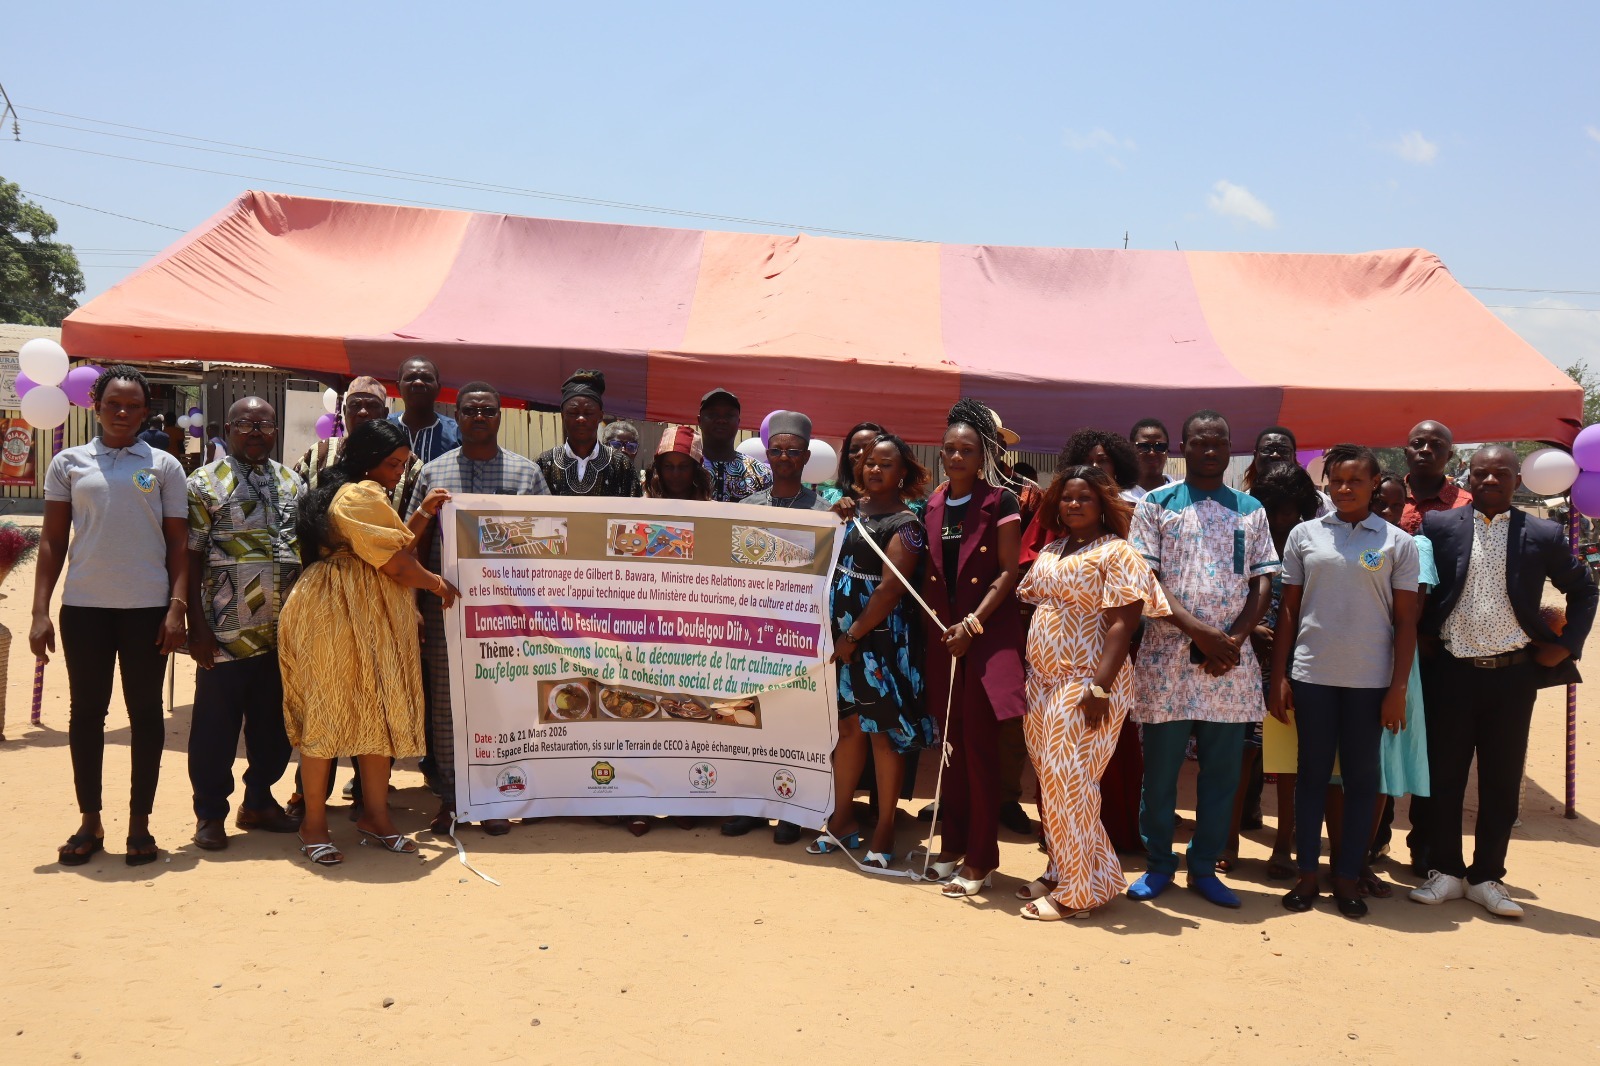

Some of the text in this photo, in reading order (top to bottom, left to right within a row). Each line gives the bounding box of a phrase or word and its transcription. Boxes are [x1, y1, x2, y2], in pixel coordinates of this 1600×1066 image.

[482, 566, 814, 595] Sous le haut patronage de Gilbert B. Bawara, Ministre des Relations avec le Parlement
[469, 585, 478, 597] et
[479, 583, 491, 596] les
[492, 584, 536, 597] Institutions
[537, 585, 546, 597] et
[547, 585, 566, 597] avec
[567, 584, 595, 601] l'appui
[596, 586, 636, 602] technique
[637, 587, 648, 600] du
[649, 588, 687, 602] Ministère
[688, 590, 699, 604] du
[700, 592, 737, 607] tourisme,
[738, 593, 749, 607] de
[750, 594, 757, 608] la
[758, 596, 785, 610] culture
[785, 599, 794, 611] et
[794, 599, 809, 613] des
[475, 611, 527, 631] Lancement
[528, 610, 560, 632] officiel
[561, 611, 574, 632] du
[575, 612, 611, 634] Festival
[613, 614, 647, 635] annuel
[657, 615, 675, 637] Taa
[676, 616, 725, 644] Doufelgou
[726, 620, 743, 642] Diit
[775, 627, 813, 650] édition
[480, 640, 515, 659] Thème
[522, 640, 591, 660] Consommons
[594, 641, 623, 663] local,
[625, 645, 633, 662] à
[635, 646, 647, 662] la
[649, 645, 708, 668] découverte
[709, 650, 723, 669] de
[725, 651, 747, 672] l'art
[748, 654, 793, 677] culinaire
[794, 660, 809, 677] de
[474, 657, 818, 694] Doufelgou sous le signe de la cohésion social et du vivre ensemble
[474, 733, 493, 744] Date
[498, 733, 508, 744] 20
[509, 732, 516, 742] &
[517, 730, 527, 741] 21
[527, 728, 547, 739] Mars
[548, 726, 568, 738] 2026
[475, 747, 491, 759] Lieu
[496, 745, 522, 760] Espace
[523, 742, 540, 754] Elda
[540, 740, 592, 753] Restauration,
[592, 739, 603, 752] sis
[603, 742, 616, 752] sur
[616, 738, 625, 752] le
[625, 739, 652, 752] Terrain
[652, 739, 662, 752] de
[663, 740, 684, 752] CECO
[685, 739, 691, 752] à
[691, 740, 711, 754] Agoè
[711, 740, 751, 757] échangeur,
[752, 743, 768, 758] près
[768, 746, 779, 758] de
[779, 748, 806, 762] DOGTA
[806, 751, 826, 765] LAFIE
